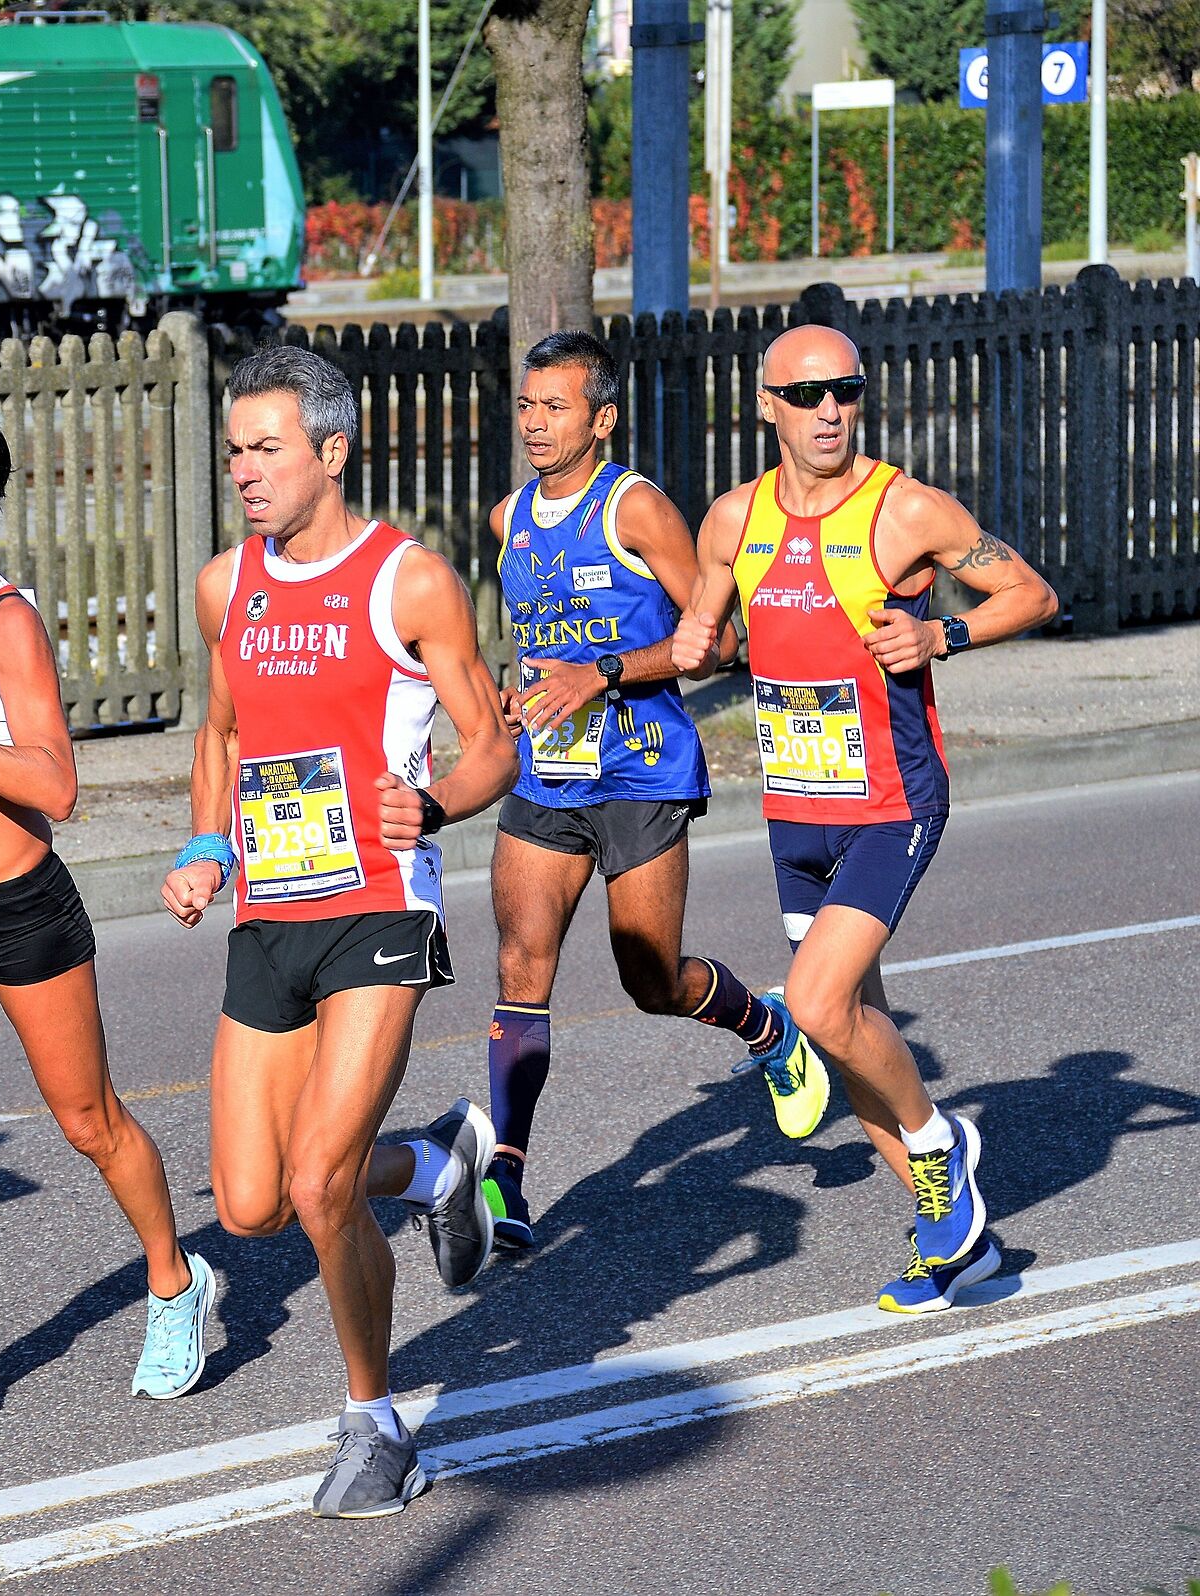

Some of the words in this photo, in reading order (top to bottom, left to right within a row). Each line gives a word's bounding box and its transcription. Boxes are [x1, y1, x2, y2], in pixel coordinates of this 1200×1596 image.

[1053, 62, 1065, 84] 7
[745, 543, 774, 554] AVIS
[826, 545, 862, 554] BERARDI
[240, 623, 350, 661] GOLDEN
[534, 616, 622, 647] LINCI
[256, 655, 319, 677] rimini
[779, 686, 817, 699] MARATONA
[777, 736, 842, 768] 2019
[258, 761, 296, 777] MARATONA
[257, 822, 325, 860] 2239
